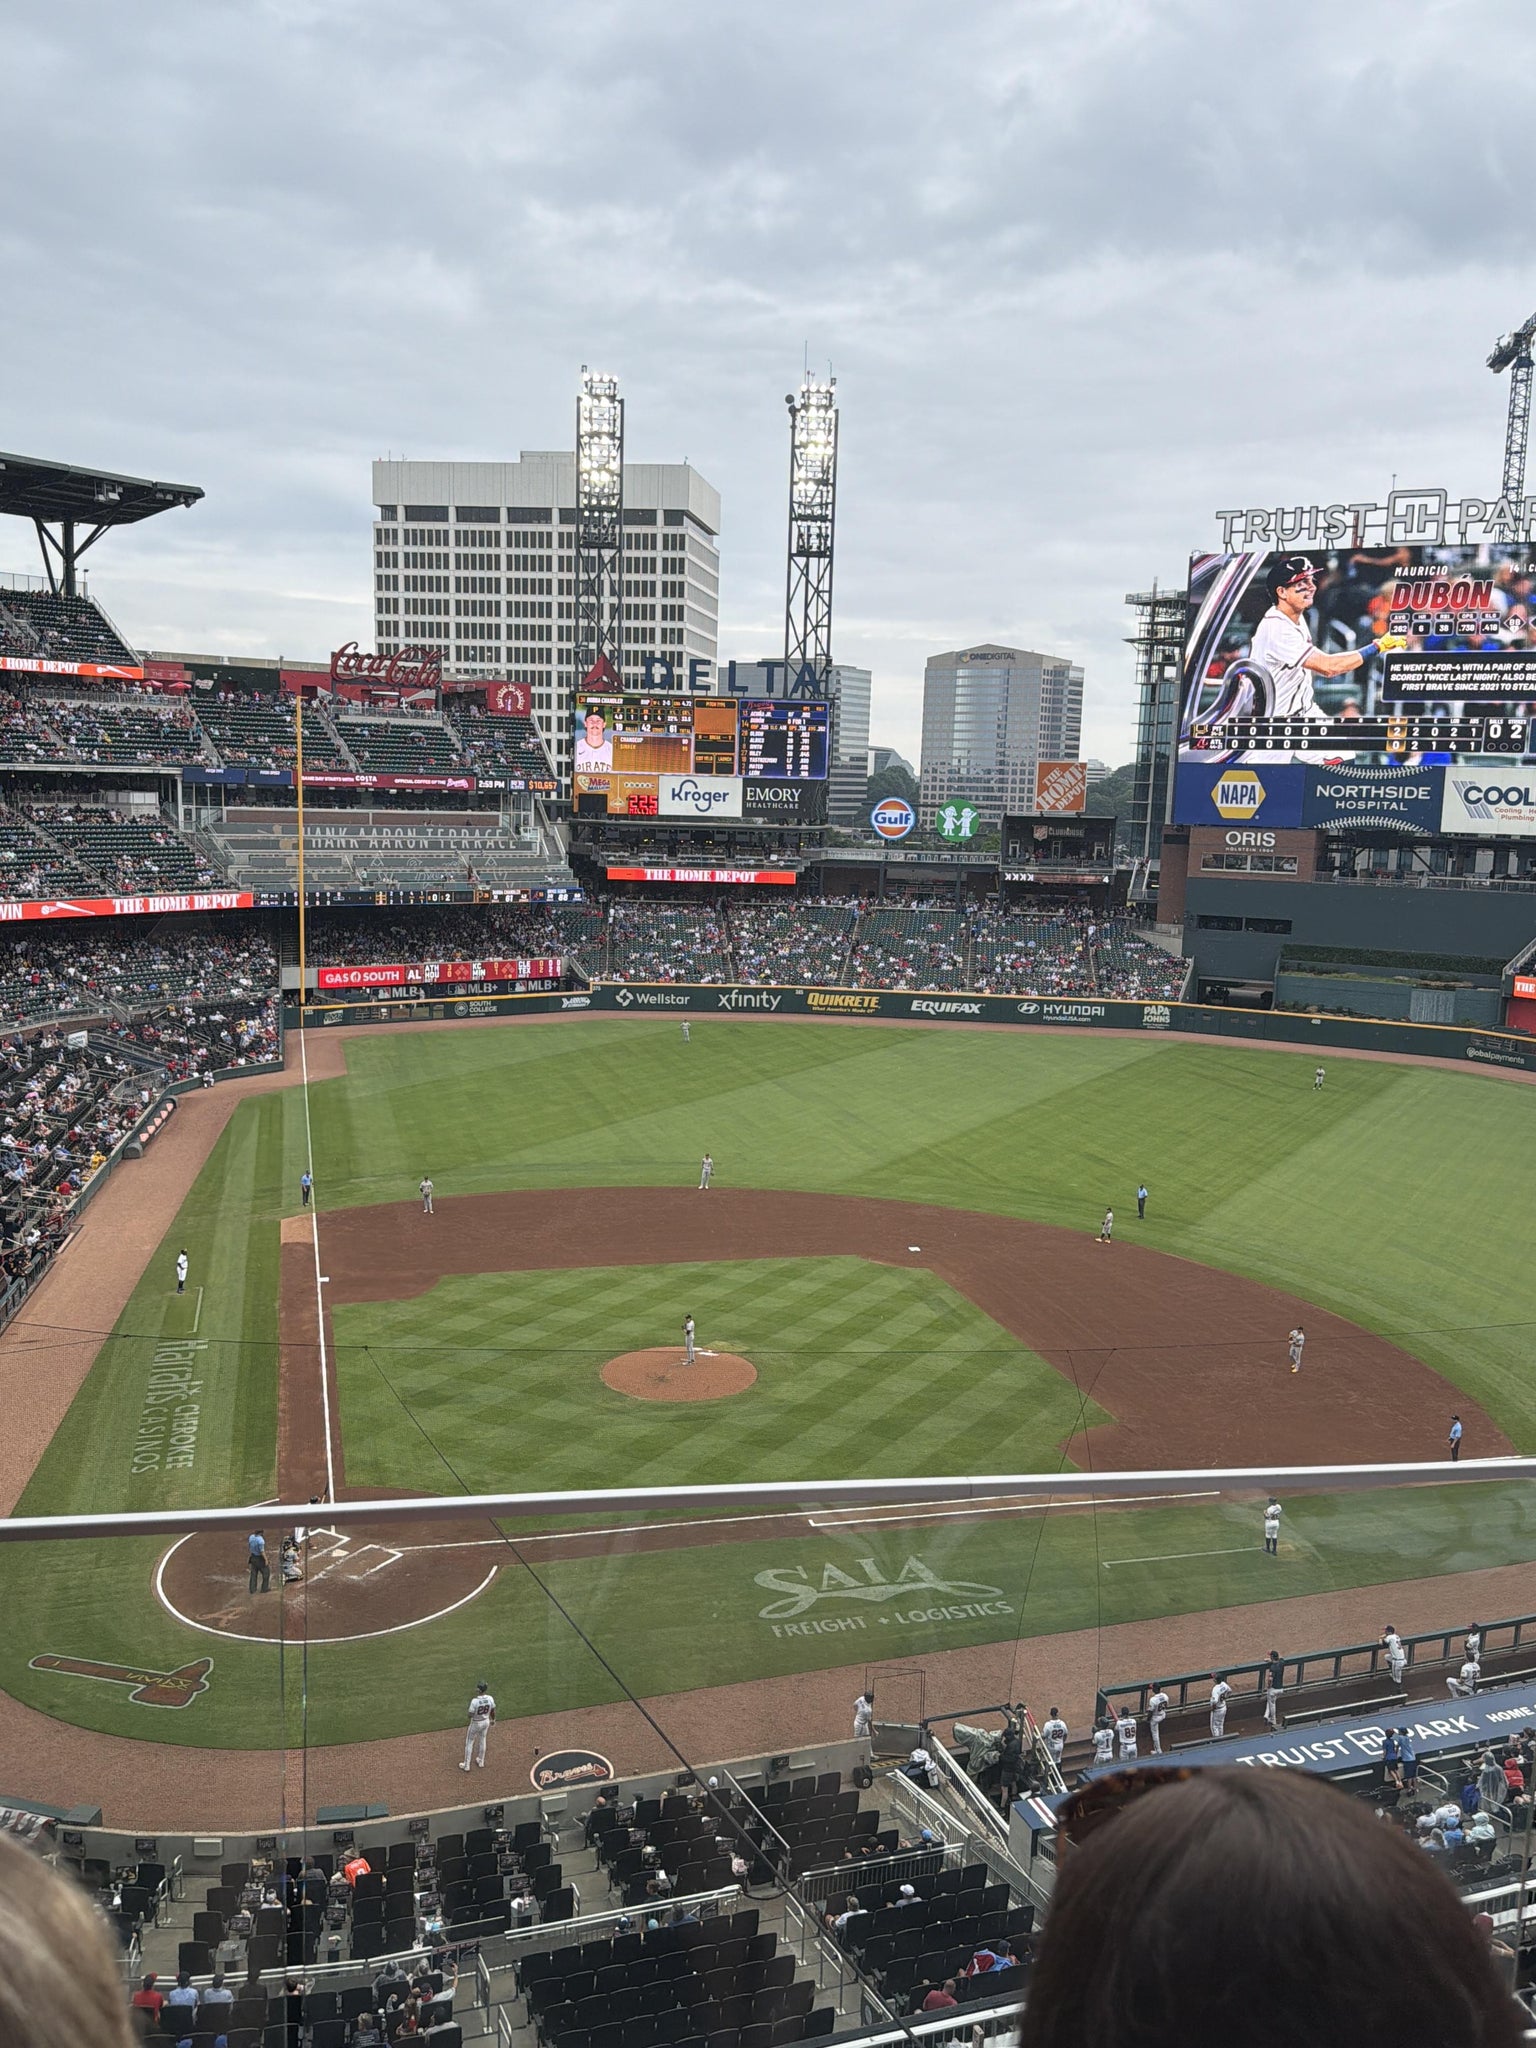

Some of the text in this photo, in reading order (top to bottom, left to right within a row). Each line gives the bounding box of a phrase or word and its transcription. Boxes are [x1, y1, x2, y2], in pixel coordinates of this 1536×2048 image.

[1216, 503, 1376, 544] TRUIST
[1394, 565, 1448, 577] MAURICIO
[1390, 573, 1495, 611] DUBÓN
[970, 652, 1016, 661] ONEDIGITAL
[6, 657, 39, 671] HOME
[42, 660, 81, 674] DEPOT
[1391, 664, 1401, 672] HE
[1403, 664, 1425, 672] WENT
[1427, 664, 1461, 672] 2-FOR-4
[1462, 664, 1484, 672] WITH
[1492, 663, 1511, 672] PAIR
[1512, 663, 1523, 671] OF
[644, 656, 822, 700] DELTA
[1450, 673, 1472, 681] LAST
[1502, 673, 1525, 681] ALSO
[1426, 683, 1453, 691] BRAVE
[1454, 683, 1479, 691] SINCE
[641, 724, 651, 732] 42
[669, 725, 677, 733] 61
[1250, 727, 1256, 735] 0
[1284, 727, 1291, 735] 0
[1302, 727, 1309, 735] 0
[1320, 727, 1327, 735] 0
[1393, 727, 1400, 735] 2
[1412, 727, 1419, 735] 2
[1431, 728, 1438, 736] 0
[1490, 724, 1523, 739] 0 2
[1232, 740, 1238, 748] 0
[1249, 740, 1255, 748] 0
[1266, 740, 1273, 748] 0
[1284, 740, 1290, 748] 0
[1301, 740, 1308, 748] 0
[1392, 742, 1399, 750] 0
[1411, 741, 1418, 750] 2
[1449, 742, 1456, 750] 4
[1042, 766, 1064, 788] THE
[1037, 763, 1087, 811] HOME
[1316, 785, 1431, 800] NORTHSIDE
[671, 779, 729, 812] Kroger
[746, 787, 802, 802] EMORY
[1055, 784, 1086, 811] DEPOT
[1220, 784, 1256, 805] NAPA
[629, 795, 658, 808] 225
[746, 802, 799, 810] HEALTHCARE
[1335, 800, 1408, 811] HOSPITAL
[1494, 807, 1522, 815] Cooling
[874, 811, 911, 826] Gulf
[1500, 814, 1535, 822] Plumbing
[303, 827, 516, 850] HANK AARON TERRACE
[1048, 826, 1084, 838] CLUBHOUSE
[1225, 831, 1276, 847] ORIS
[644, 868, 758, 883] THE HOME DEPOT
[112, 894, 241, 914] THE HOME DEPOT
[325, 971, 400, 983] GAS SOUTH
[408, 970, 421, 980] AL
[472, 969, 486, 977] MIN
[468, 983, 498, 994] MLB+
[528, 980, 558, 991] MLB+
[1515, 981, 1535, 994] THE
[636, 993, 690, 1005] Wellstar
[718, 989, 782, 1011] xfinity
[807, 992, 880, 1008] QUIKRETE
[911, 1000, 981, 1015] EQUIFAX
[1043, 1004, 1105, 1016] HYUNDAI
[1144, 1005, 1169, 1015] PAPA
[1142, 1015, 1171, 1023] JOHNS
[131, 1406, 169, 1473] CASINOS
[165, 1404, 200, 1470] CHEROKEE
[771, 1601, 1014, 1638] FREIGHT LOGISTICS
[477, 1704, 490, 1716] 28
[1052, 1729, 1064, 1739] 22
[1124, 1727, 1136, 1738] 89
[1236, 1738, 1343, 1767] TRUIST
[1485, 1706, 1532, 1723] HOME
[1105, 1736, 1110, 1746] 1
[539, 1762, 594, 1786] Braves
